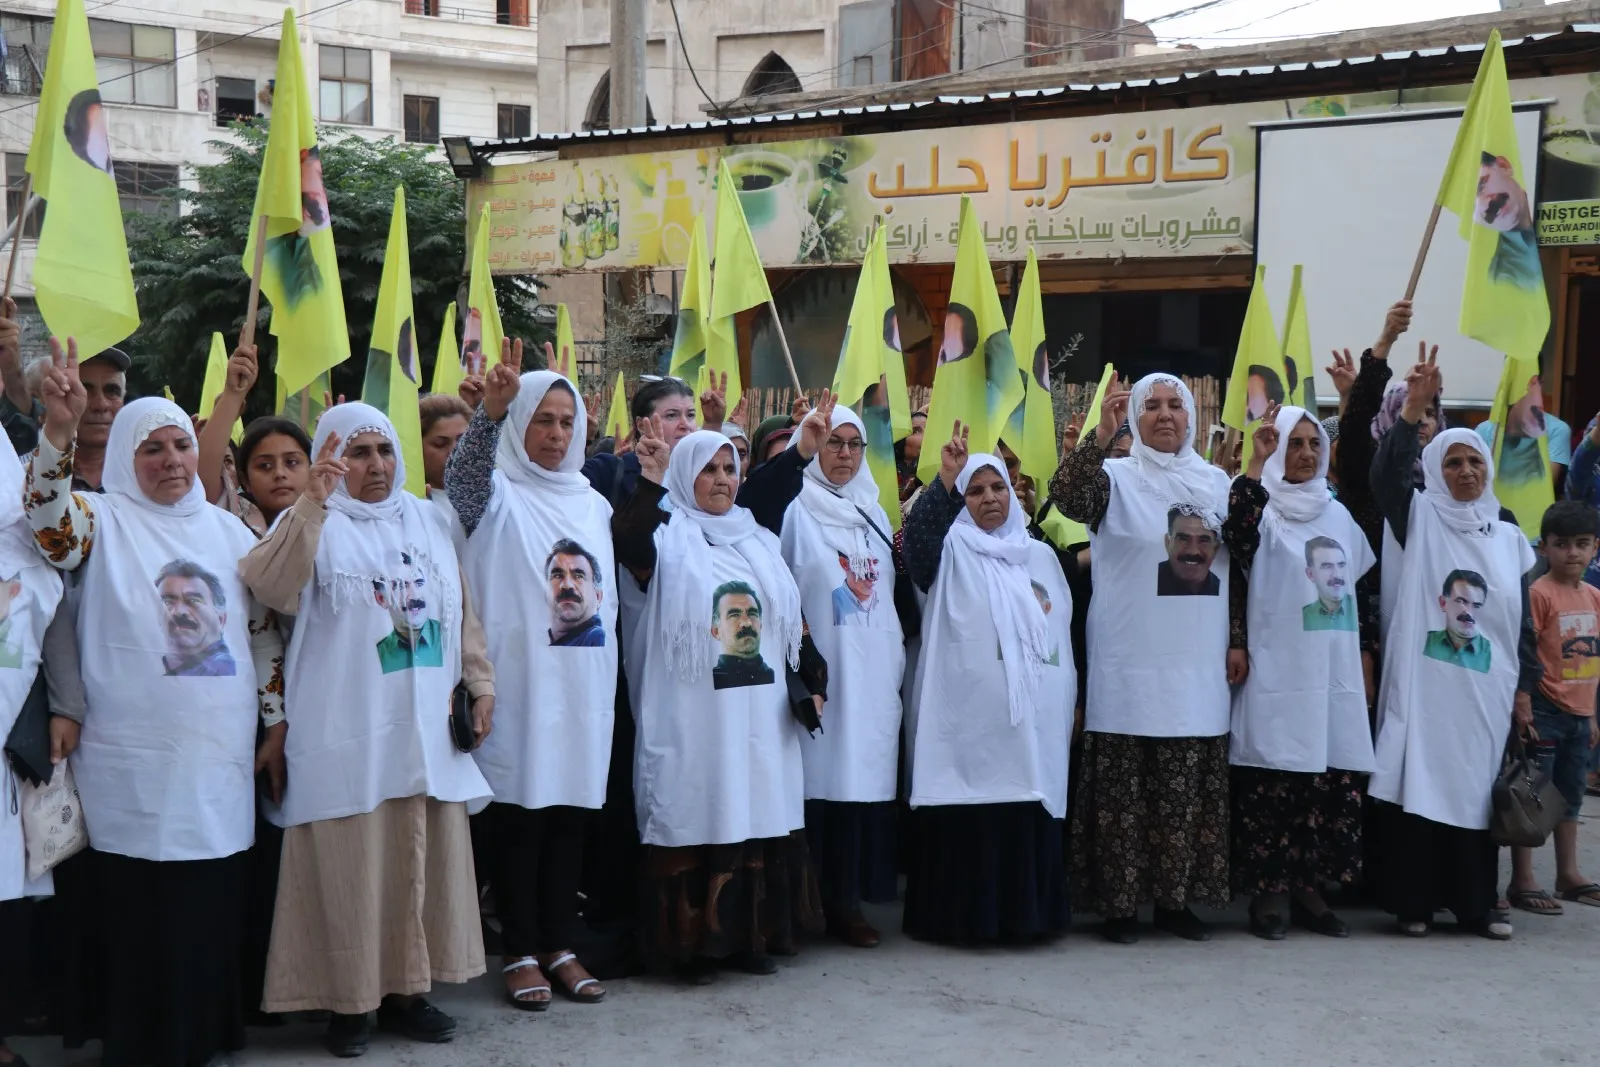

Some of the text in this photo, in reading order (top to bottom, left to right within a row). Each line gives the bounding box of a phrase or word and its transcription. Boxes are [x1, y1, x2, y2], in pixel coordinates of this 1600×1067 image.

[868, 124, 1230, 214] كافتريا حلب
[857, 217, 928, 252] أراكل
[948, 220, 1018, 250] وباة
[1025, 216, 1114, 241] ساخنة
[1120, 206, 1241, 246] مشروبات
[1542, 221, 1600, 232] VEXWARDI
